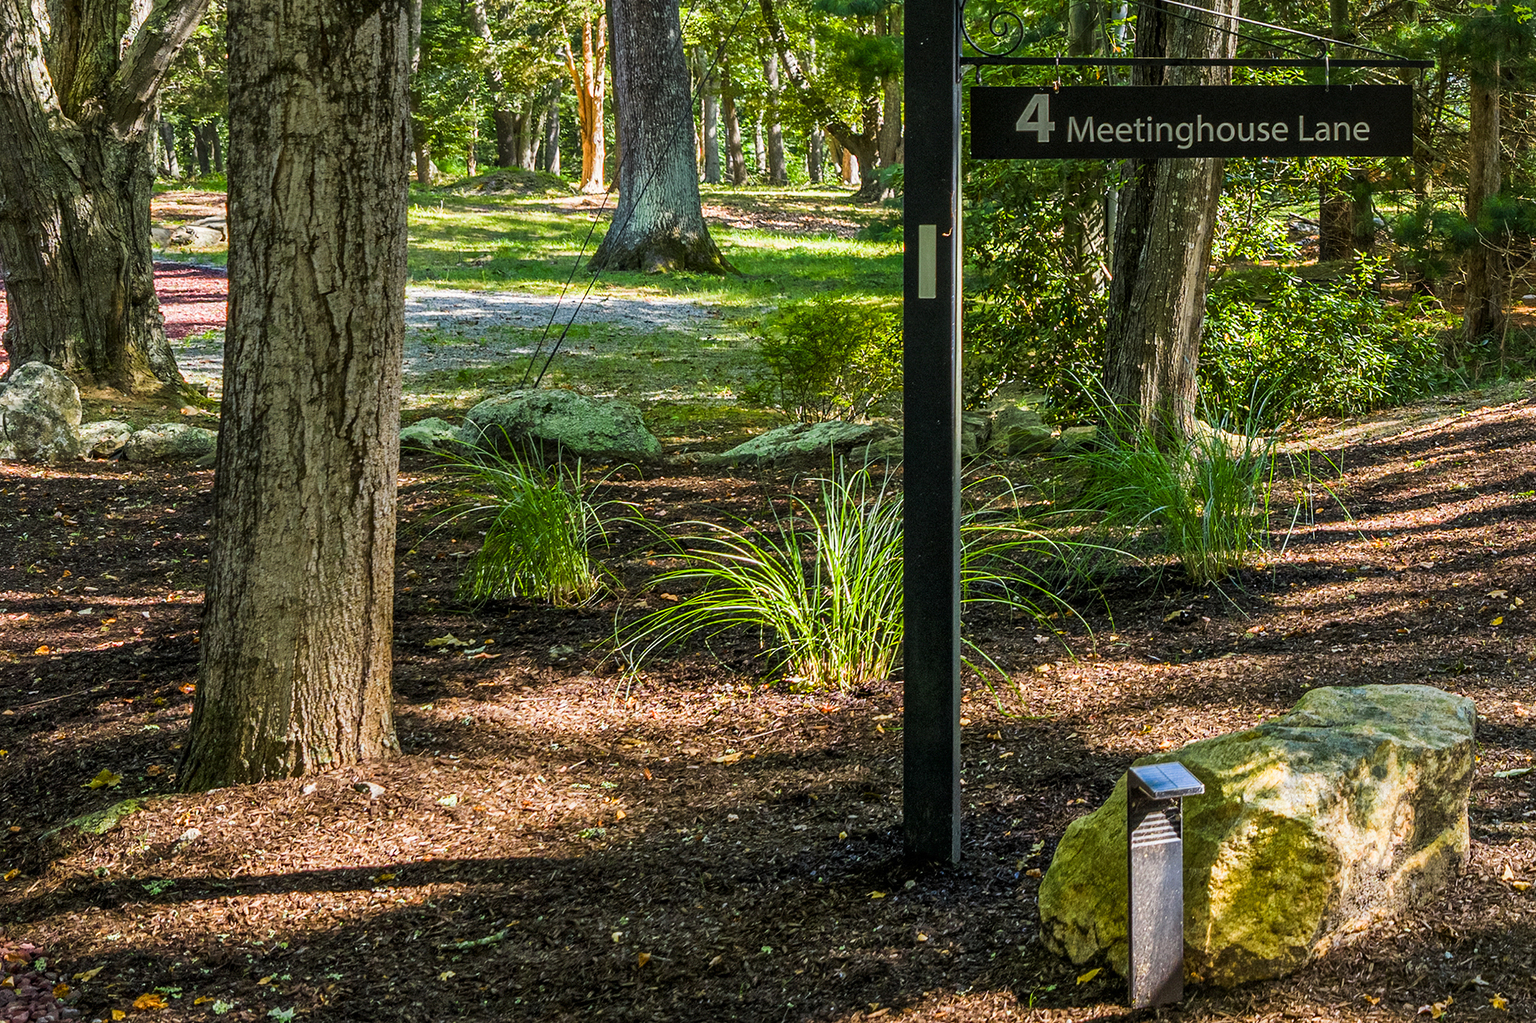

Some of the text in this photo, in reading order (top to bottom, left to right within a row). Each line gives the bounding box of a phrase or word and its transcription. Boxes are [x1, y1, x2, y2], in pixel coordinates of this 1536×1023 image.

[1015, 93, 1370, 150] 4 Meetinghouse Lane
